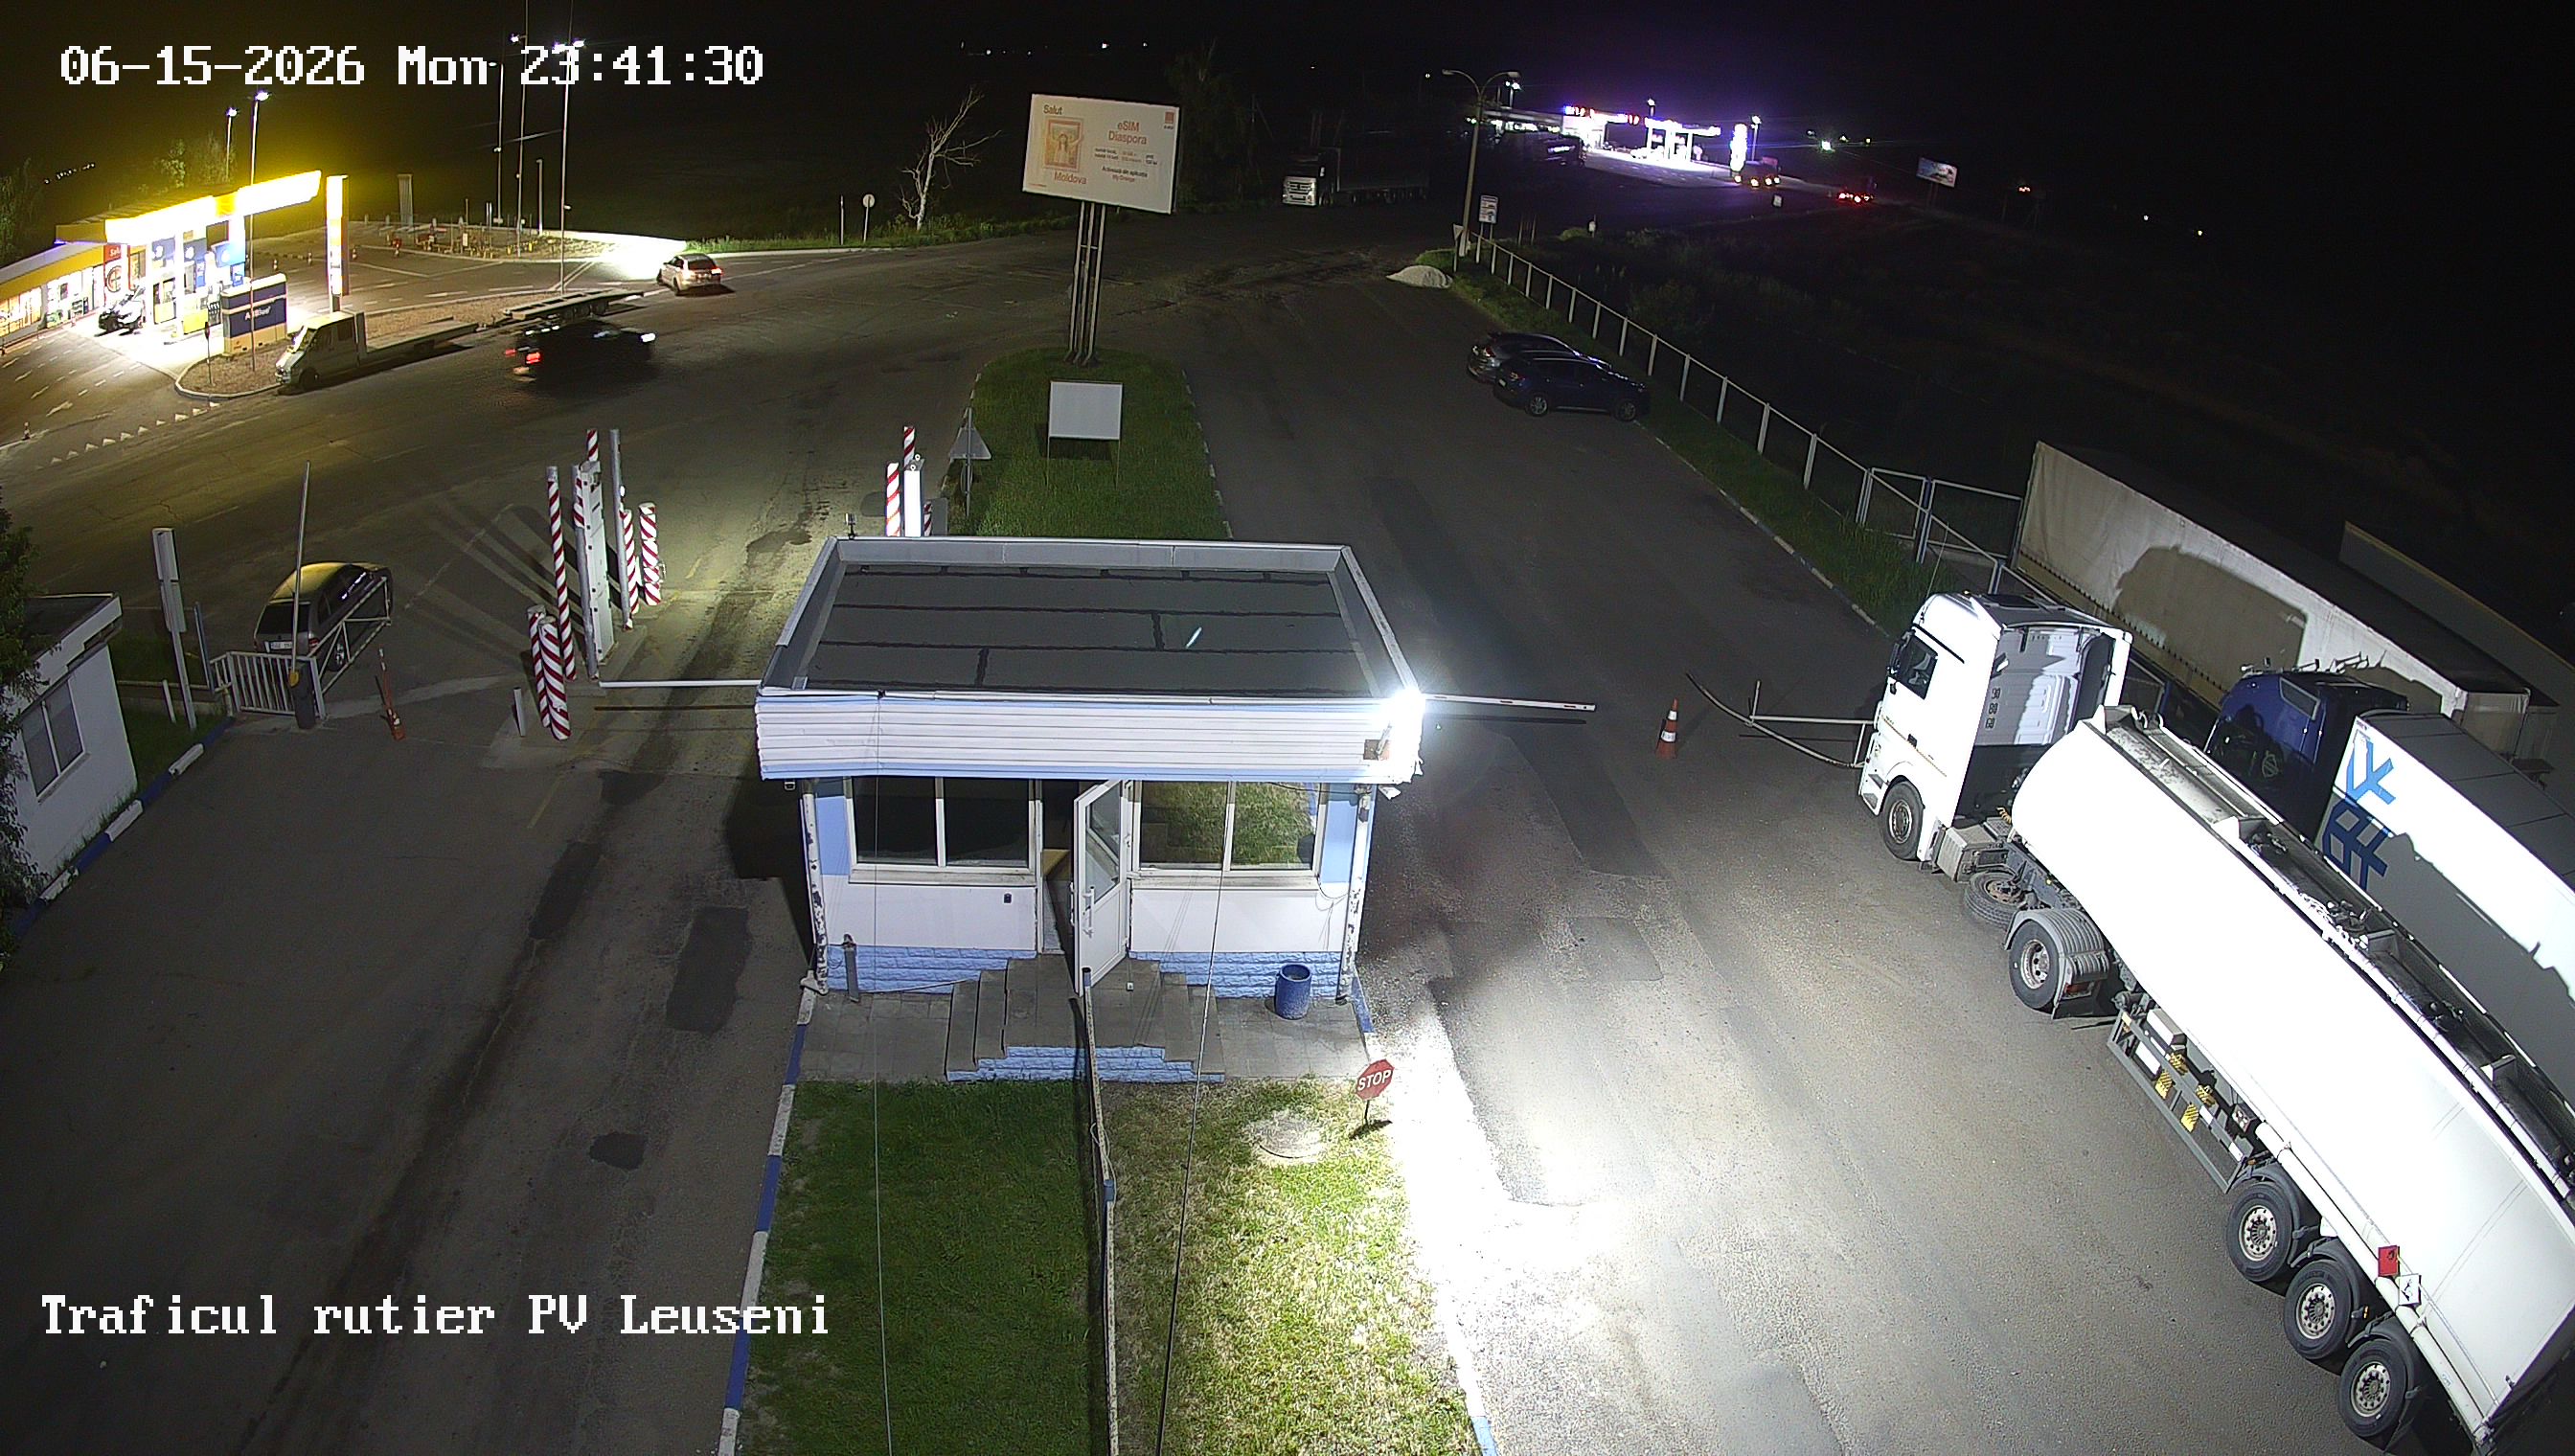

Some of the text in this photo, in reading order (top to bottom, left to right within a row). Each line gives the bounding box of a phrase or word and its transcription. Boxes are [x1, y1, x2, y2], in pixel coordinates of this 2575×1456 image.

[1043, 104, 1062, 115] Salut
[1117, 121, 1139, 132] eSIM
[1108, 131, 1147, 145] Diaspora
[1054, 172, 1086, 185] Moldova
[1357, 1069, 1391, 1090] STOP
